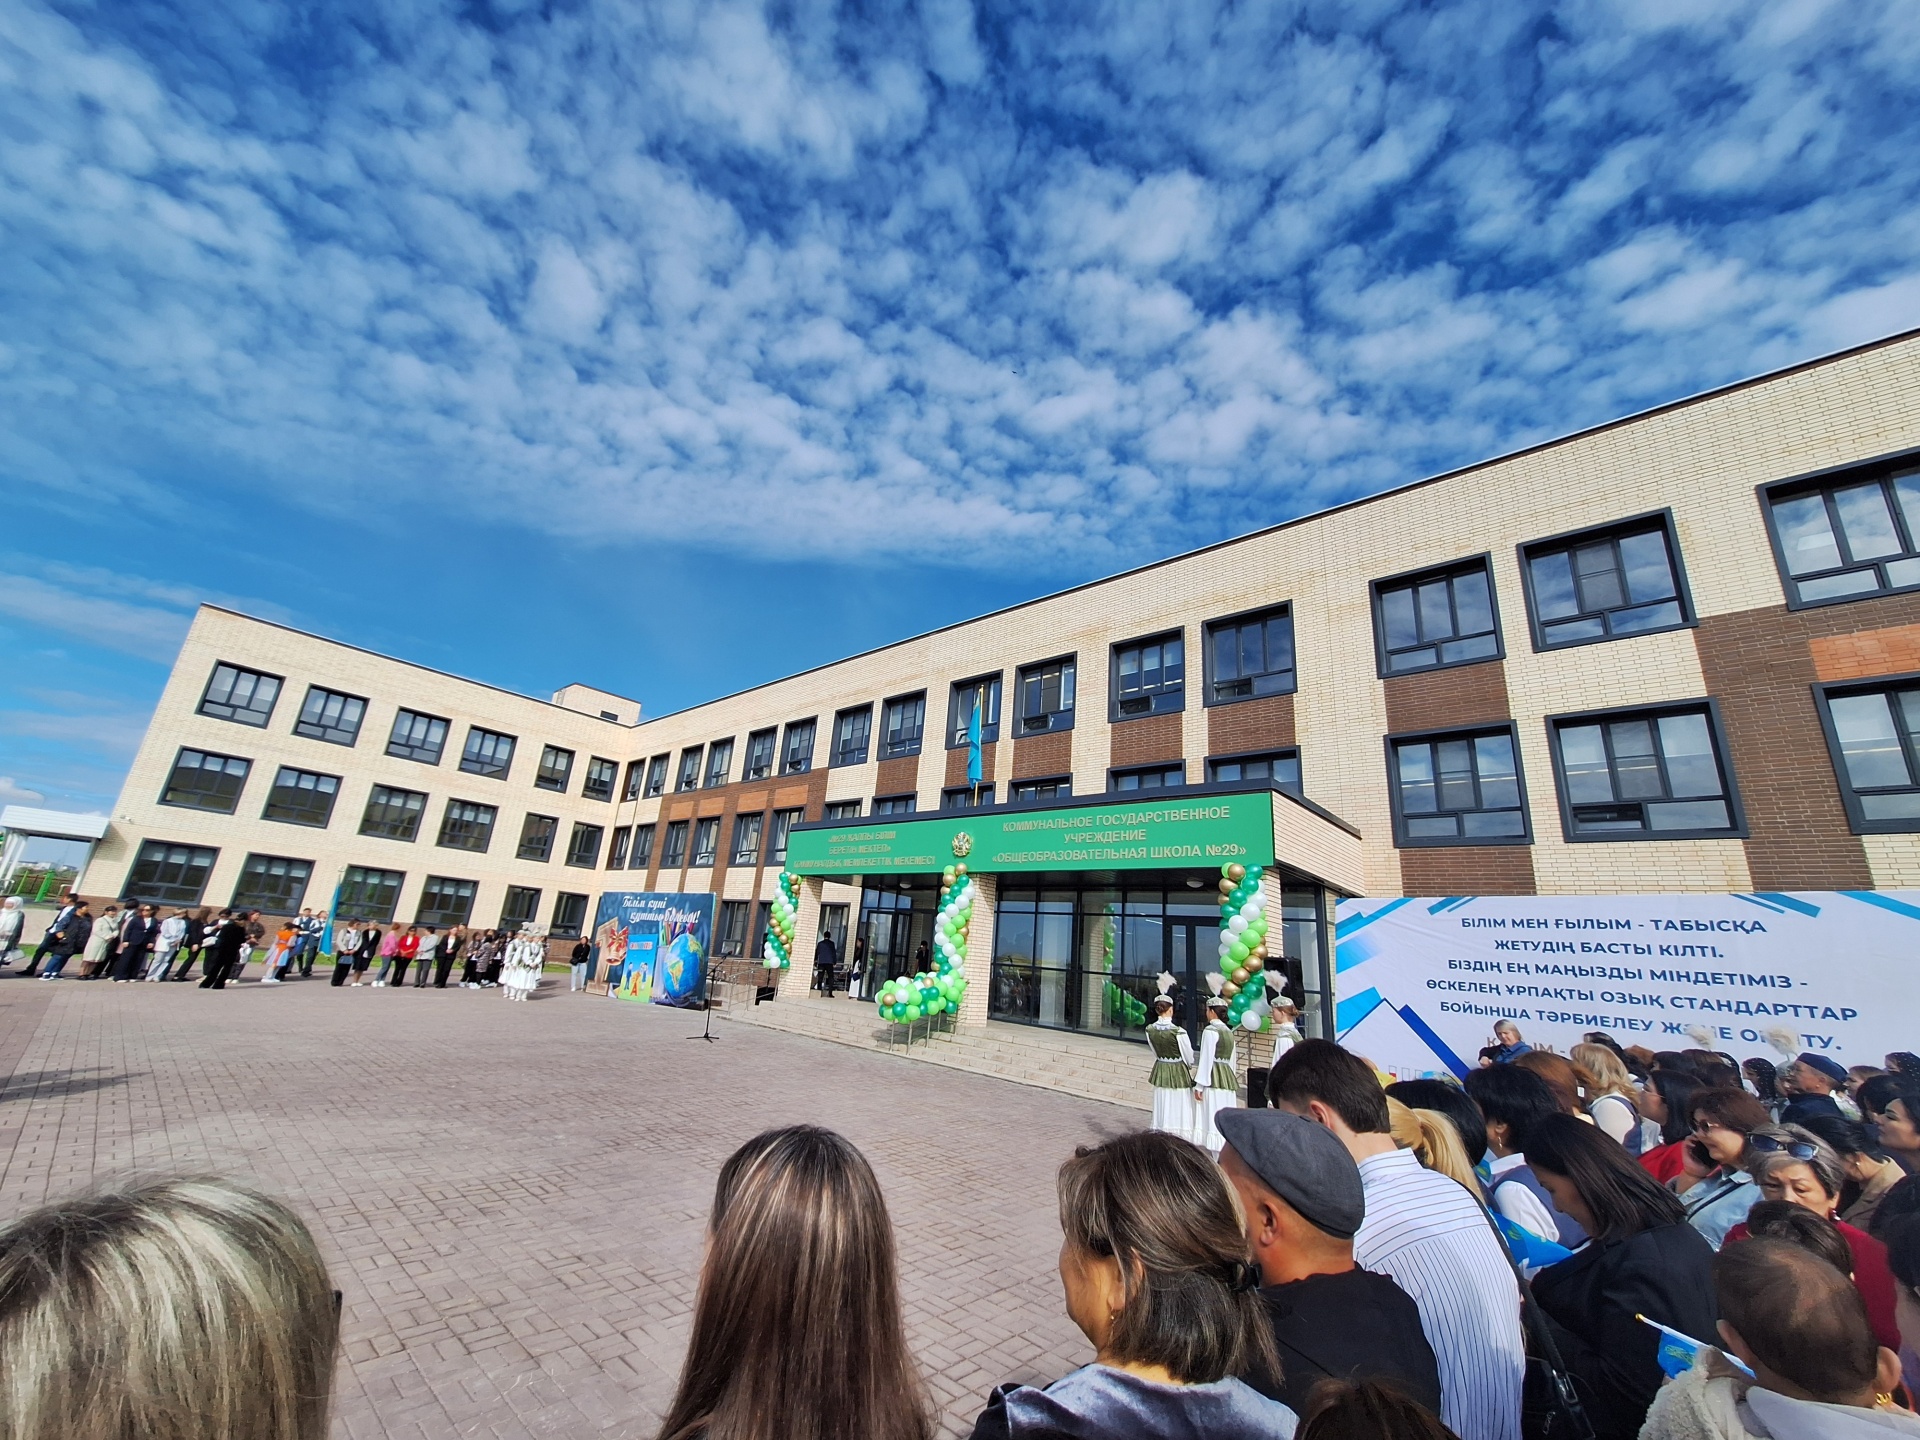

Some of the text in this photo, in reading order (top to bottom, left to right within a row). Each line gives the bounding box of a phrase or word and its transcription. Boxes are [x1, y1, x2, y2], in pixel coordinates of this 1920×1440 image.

[1003, 806, 1230, 832] КОММУНАЛЬНОЕ ГОСУДАРСТВЕННОЕ
[1063, 829, 1147, 844] УЧРЕЖДЕНИЕ
[992, 843, 1247, 863] «ОБЩЕОБРАЗОВАТЕЛЬНАЯ ШКОЛА №29»
[1461, 918, 1506, 928] БІЛІМ
[1511, 918, 1549, 929] МЕН
[1554, 918, 1632, 930] ҒЫЛЫМ
[1650, 919, 1768, 935] ТАБЫСҚА
[1494, 940, 1724, 958] ЖЕТУДІҢ БАСТЫ КІЛТІ.
[1448, 959, 1502, 974] БІЗДІҢ
[1506, 962, 1530, 976] ЕҢ
[1534, 963, 1642, 981] МАҢЫЗДЫ
[1650, 969, 1792, 989] МІНДЕТІМІЗ
[1426, 979, 1858, 1021] ӨСКЕЛЕҢ ҰРПАҚТЫ ОЗЫҚ СТАНДАРТТАР
[1440, 1001, 1842, 1050] БОЙЫНША ТӘРБИЕЛЕУ ЖЕ ОТУ.
